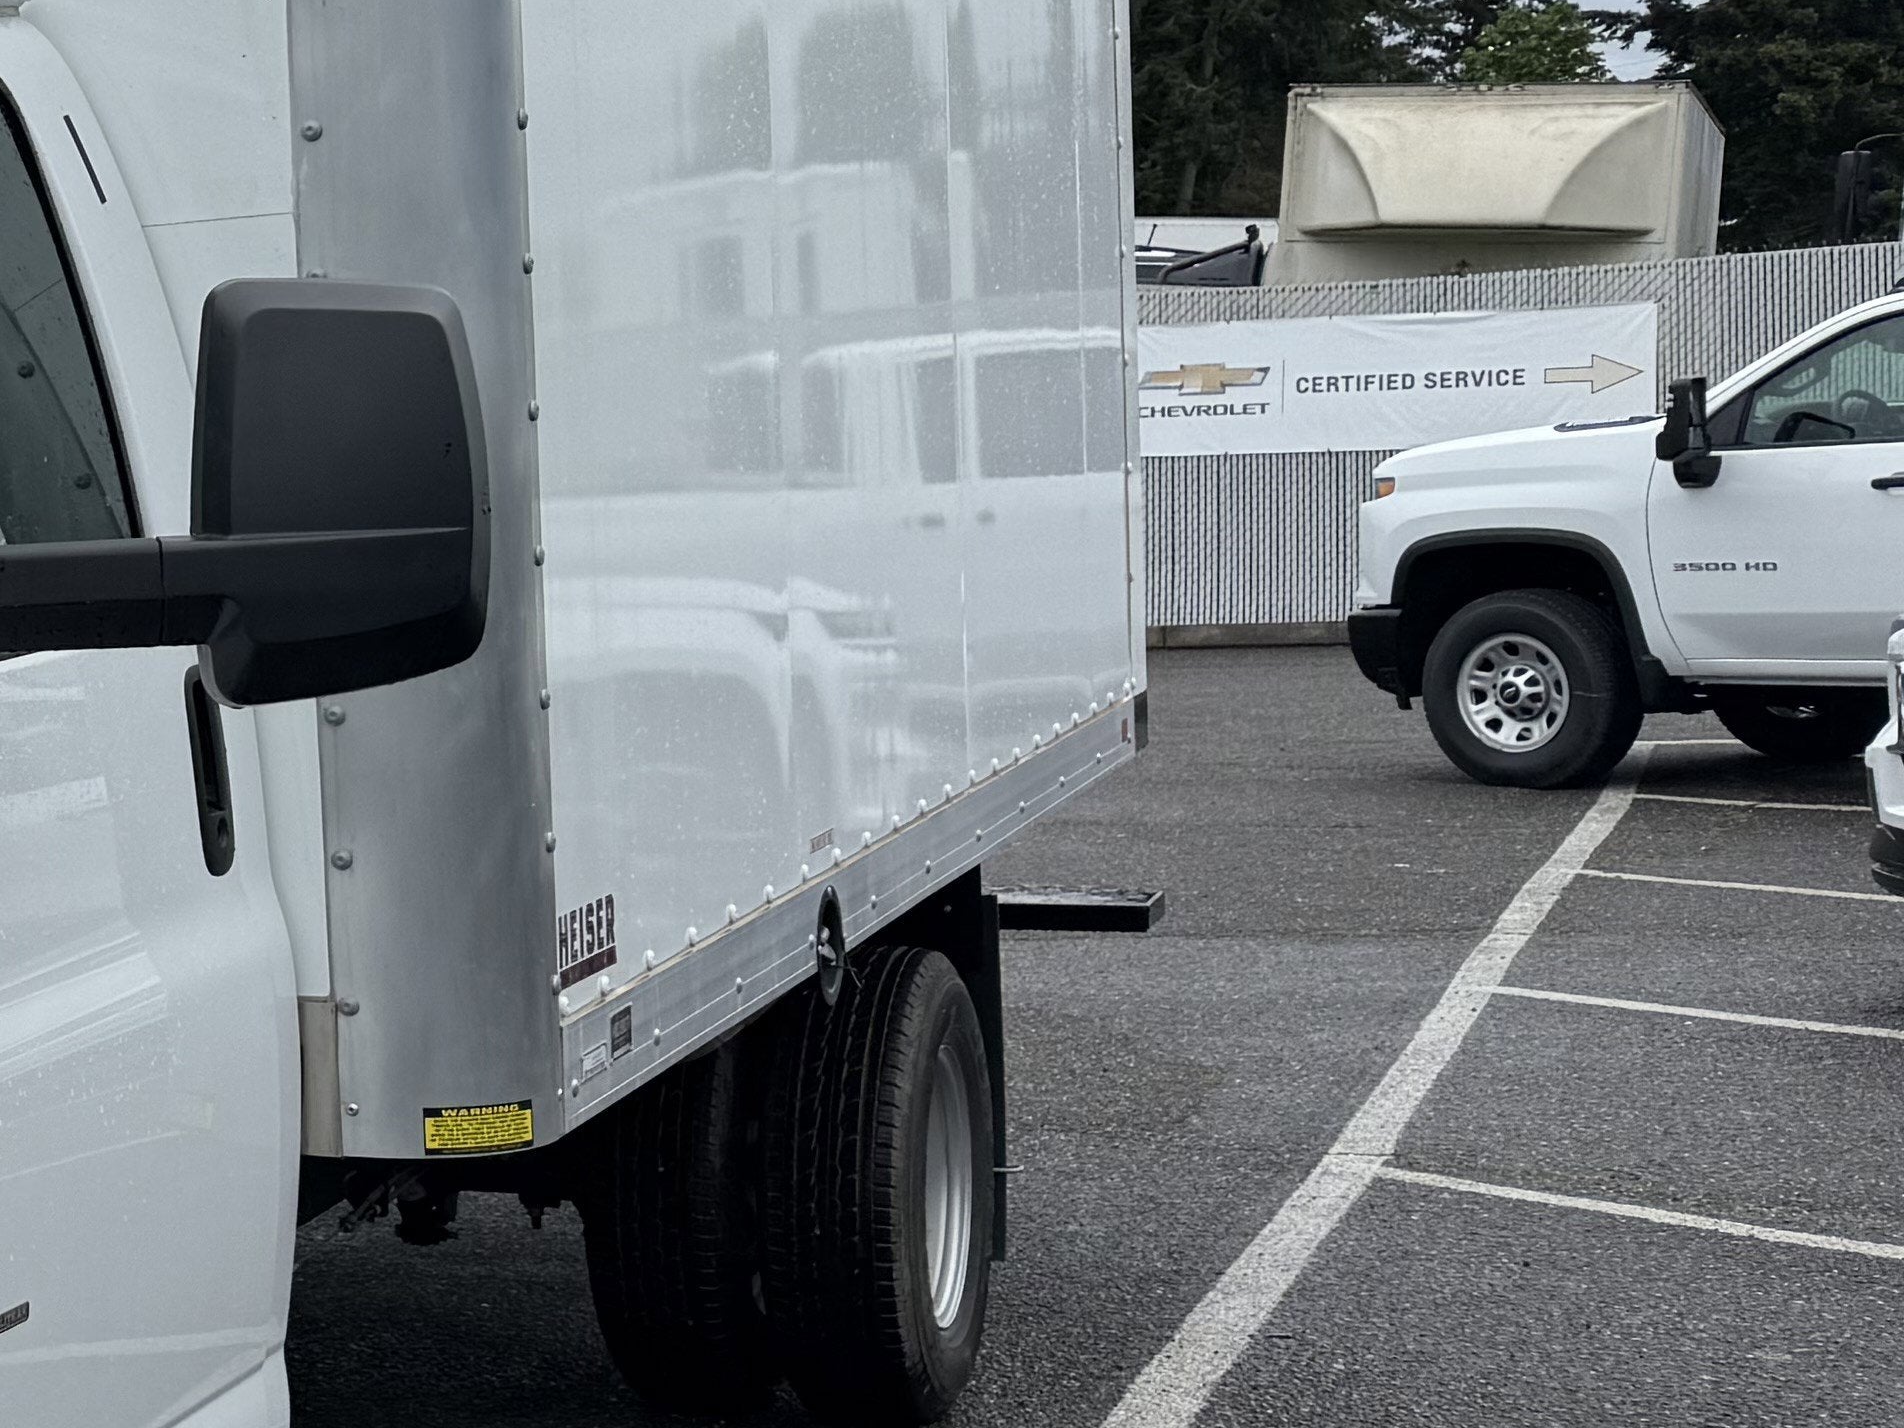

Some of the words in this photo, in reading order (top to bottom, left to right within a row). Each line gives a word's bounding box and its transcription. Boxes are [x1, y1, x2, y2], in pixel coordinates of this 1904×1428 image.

[1295, 372, 1416, 394] CERTIFIED
[1423, 369, 1526, 389] SERVICE
[1138, 402, 1270, 418] CHEVROLET
[1672, 562, 1737, 572] 3500
[1744, 561, 1778, 572] HD
[558, 893, 616, 970] HEISER
[441, 1104, 519, 1117] WARNING
